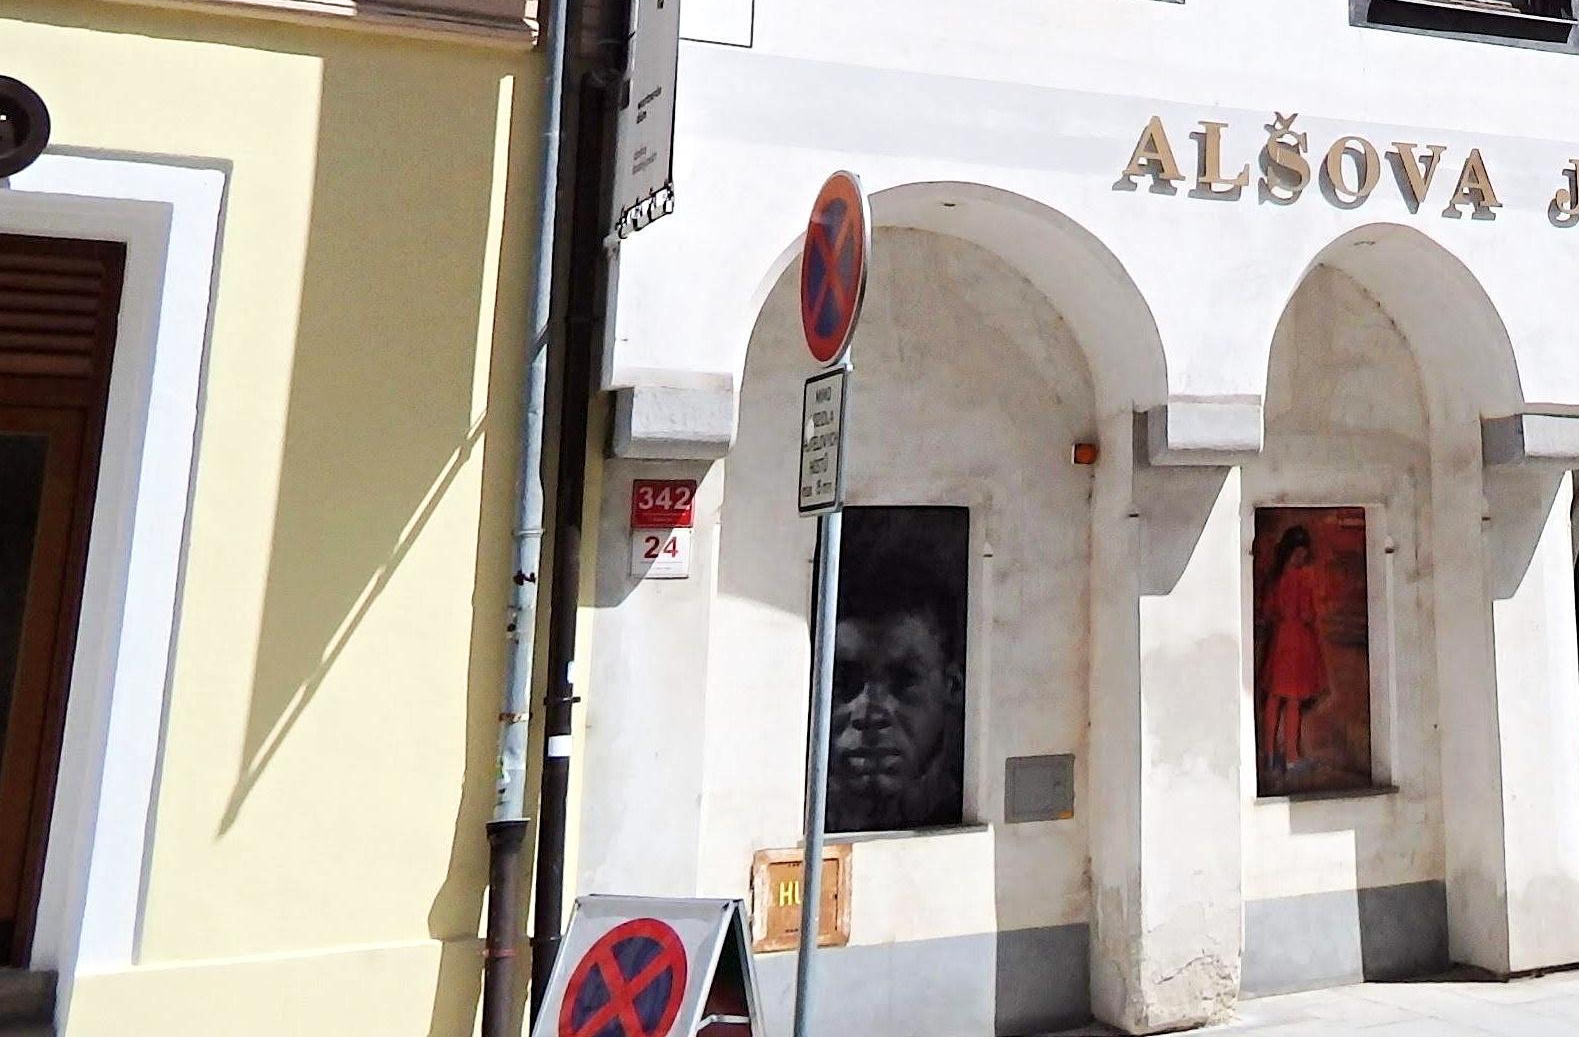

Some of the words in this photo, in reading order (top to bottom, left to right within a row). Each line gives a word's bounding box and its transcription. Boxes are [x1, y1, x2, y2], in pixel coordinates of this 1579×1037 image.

[1120, 111, 1503, 210] ALŠOVA
[638, 486, 692, 511] 342
[643, 535, 680, 559] 24
